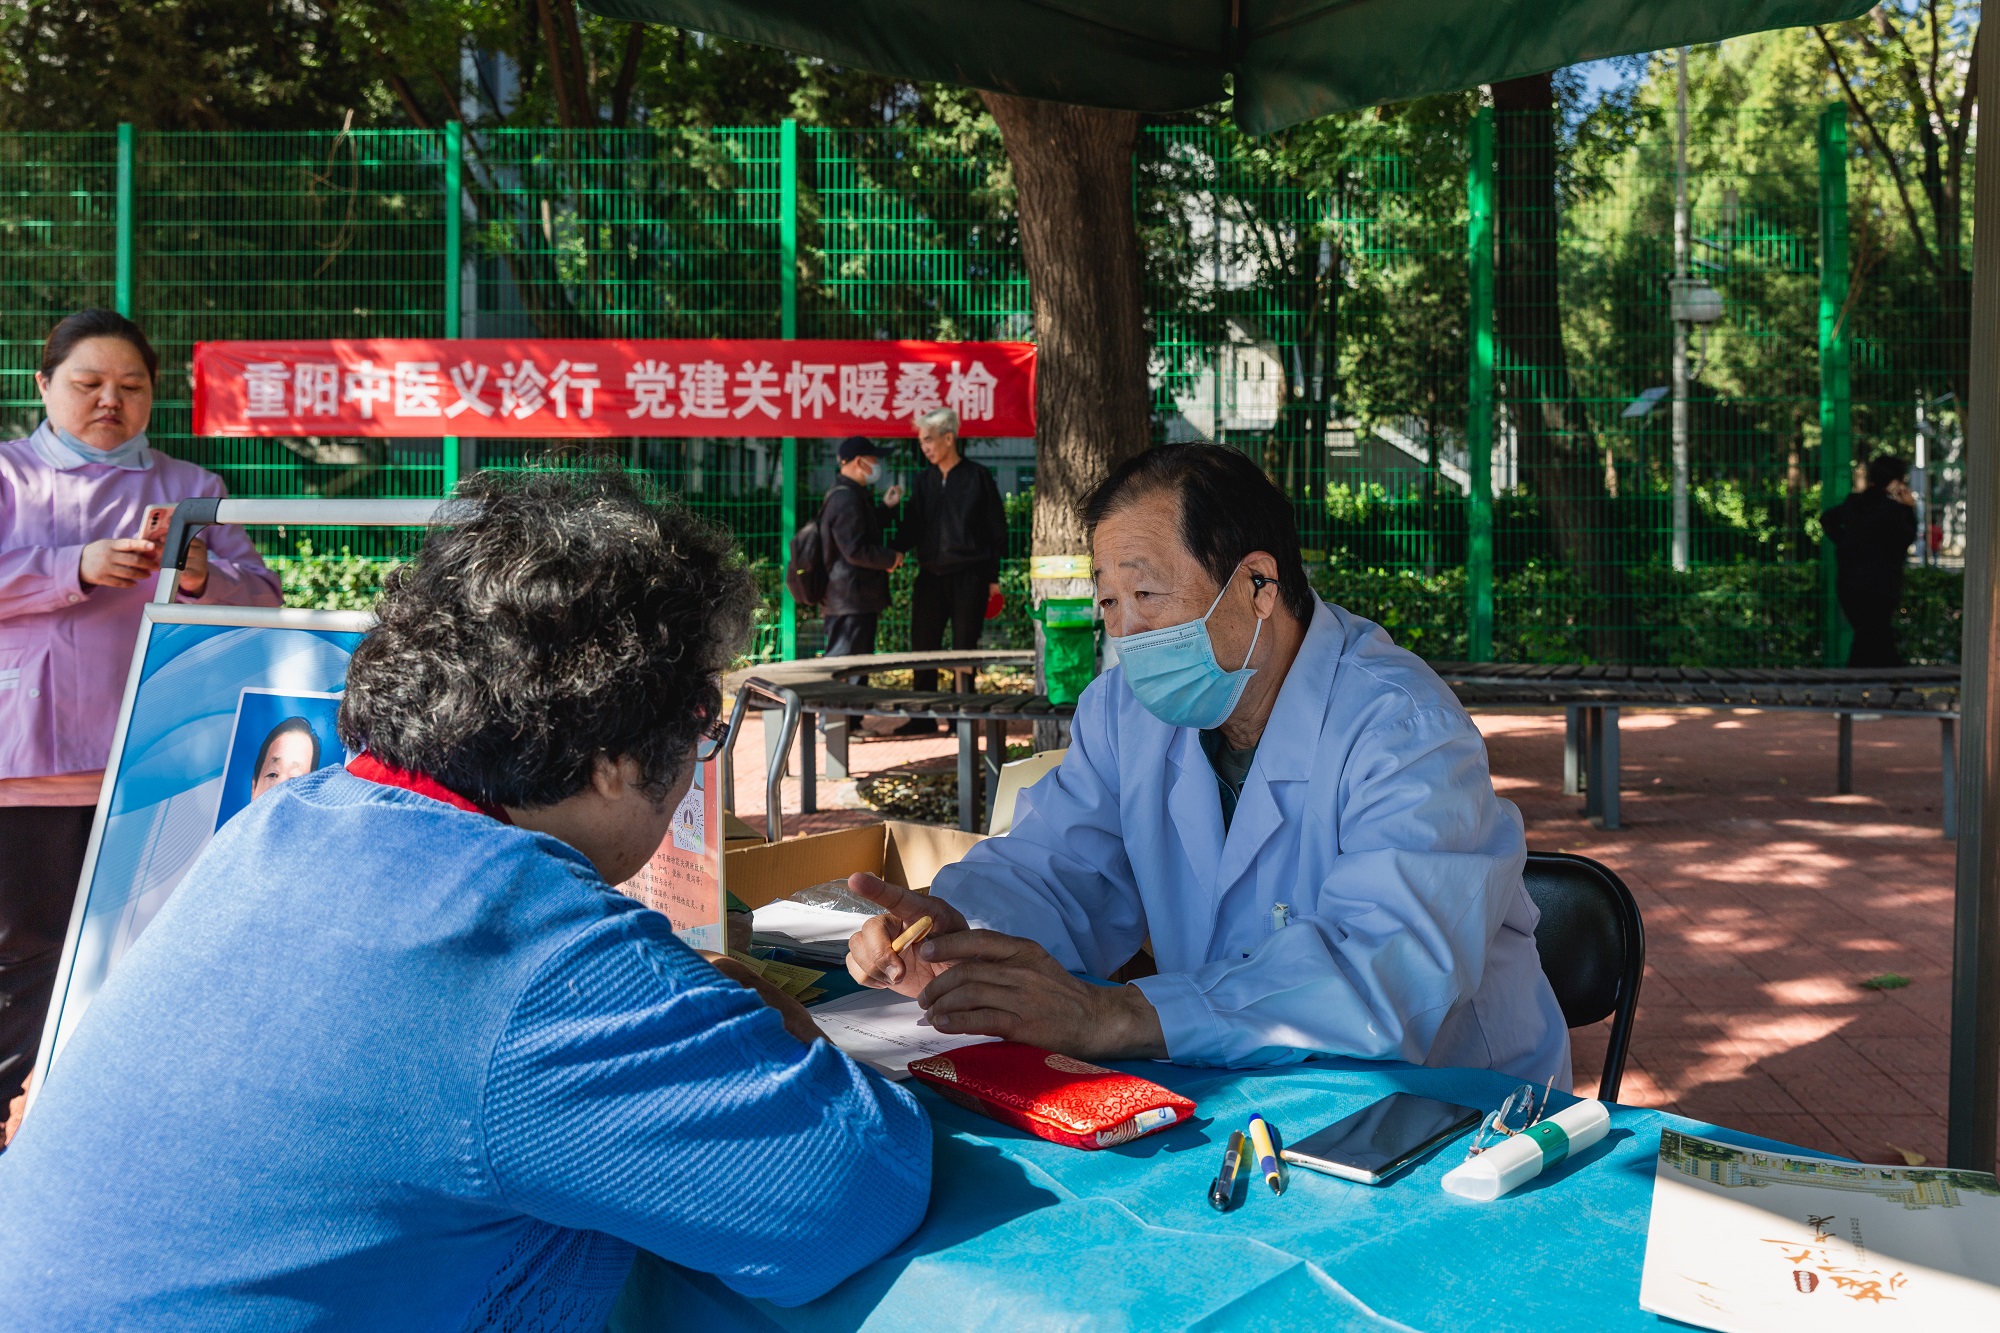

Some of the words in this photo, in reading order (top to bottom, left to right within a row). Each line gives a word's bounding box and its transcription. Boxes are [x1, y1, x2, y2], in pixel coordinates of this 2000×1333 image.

[242, 359, 601, 419] 重阳中医义诊行
[625, 359, 999, 422] 党建关怀暖桑榆
